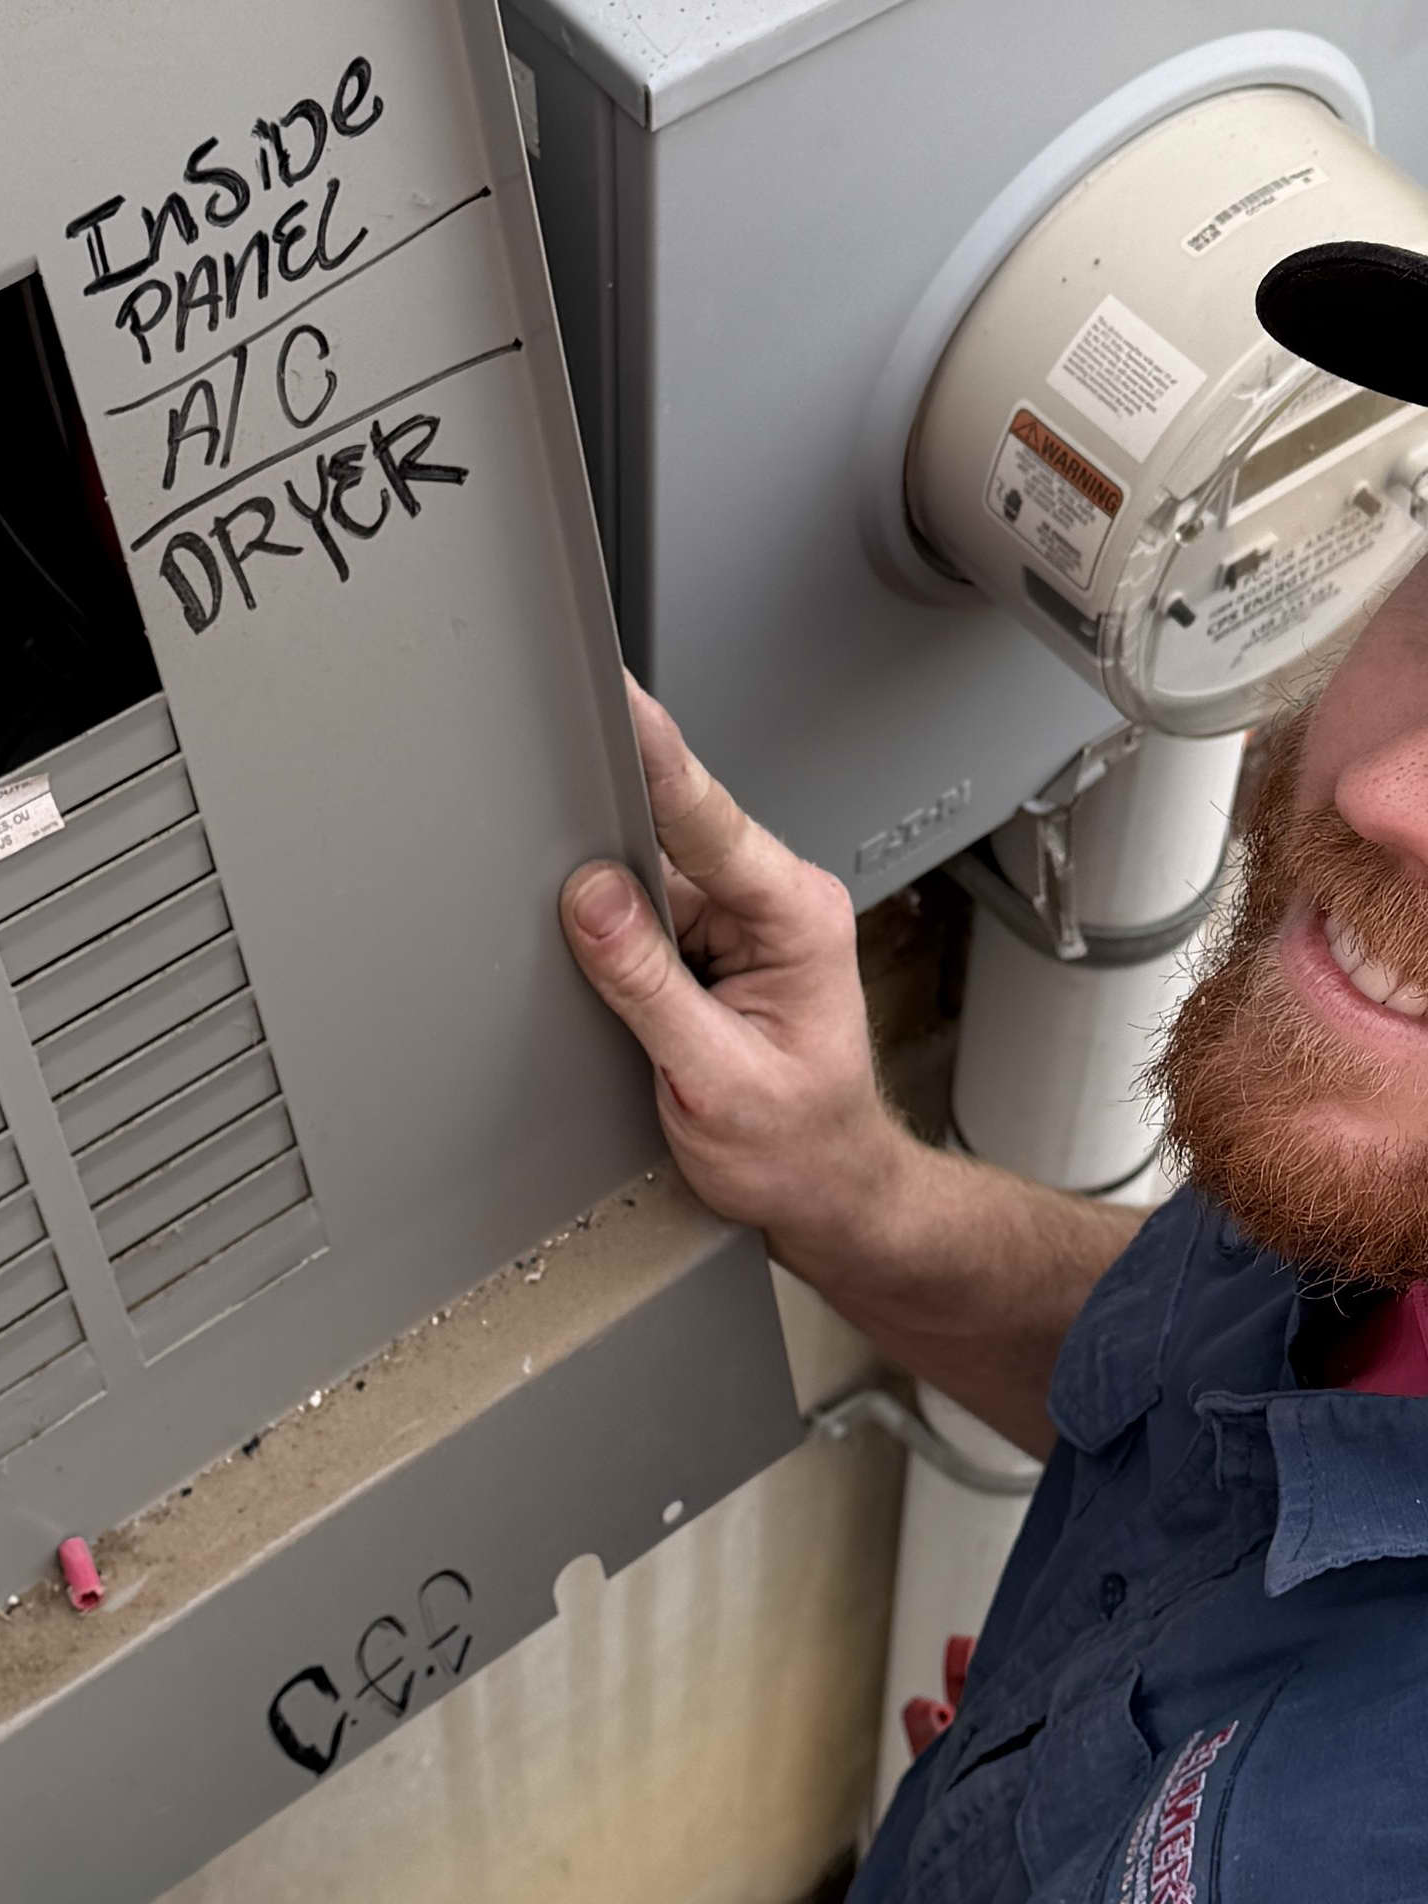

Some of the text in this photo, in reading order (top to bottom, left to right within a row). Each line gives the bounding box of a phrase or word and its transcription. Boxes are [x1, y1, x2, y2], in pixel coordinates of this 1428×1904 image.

[162, 324, 339, 491] A/C
[158, 413, 471, 636] DRYER
[1040, 434, 1119, 513] WARNING
[13, 810, 31, 825] OU
